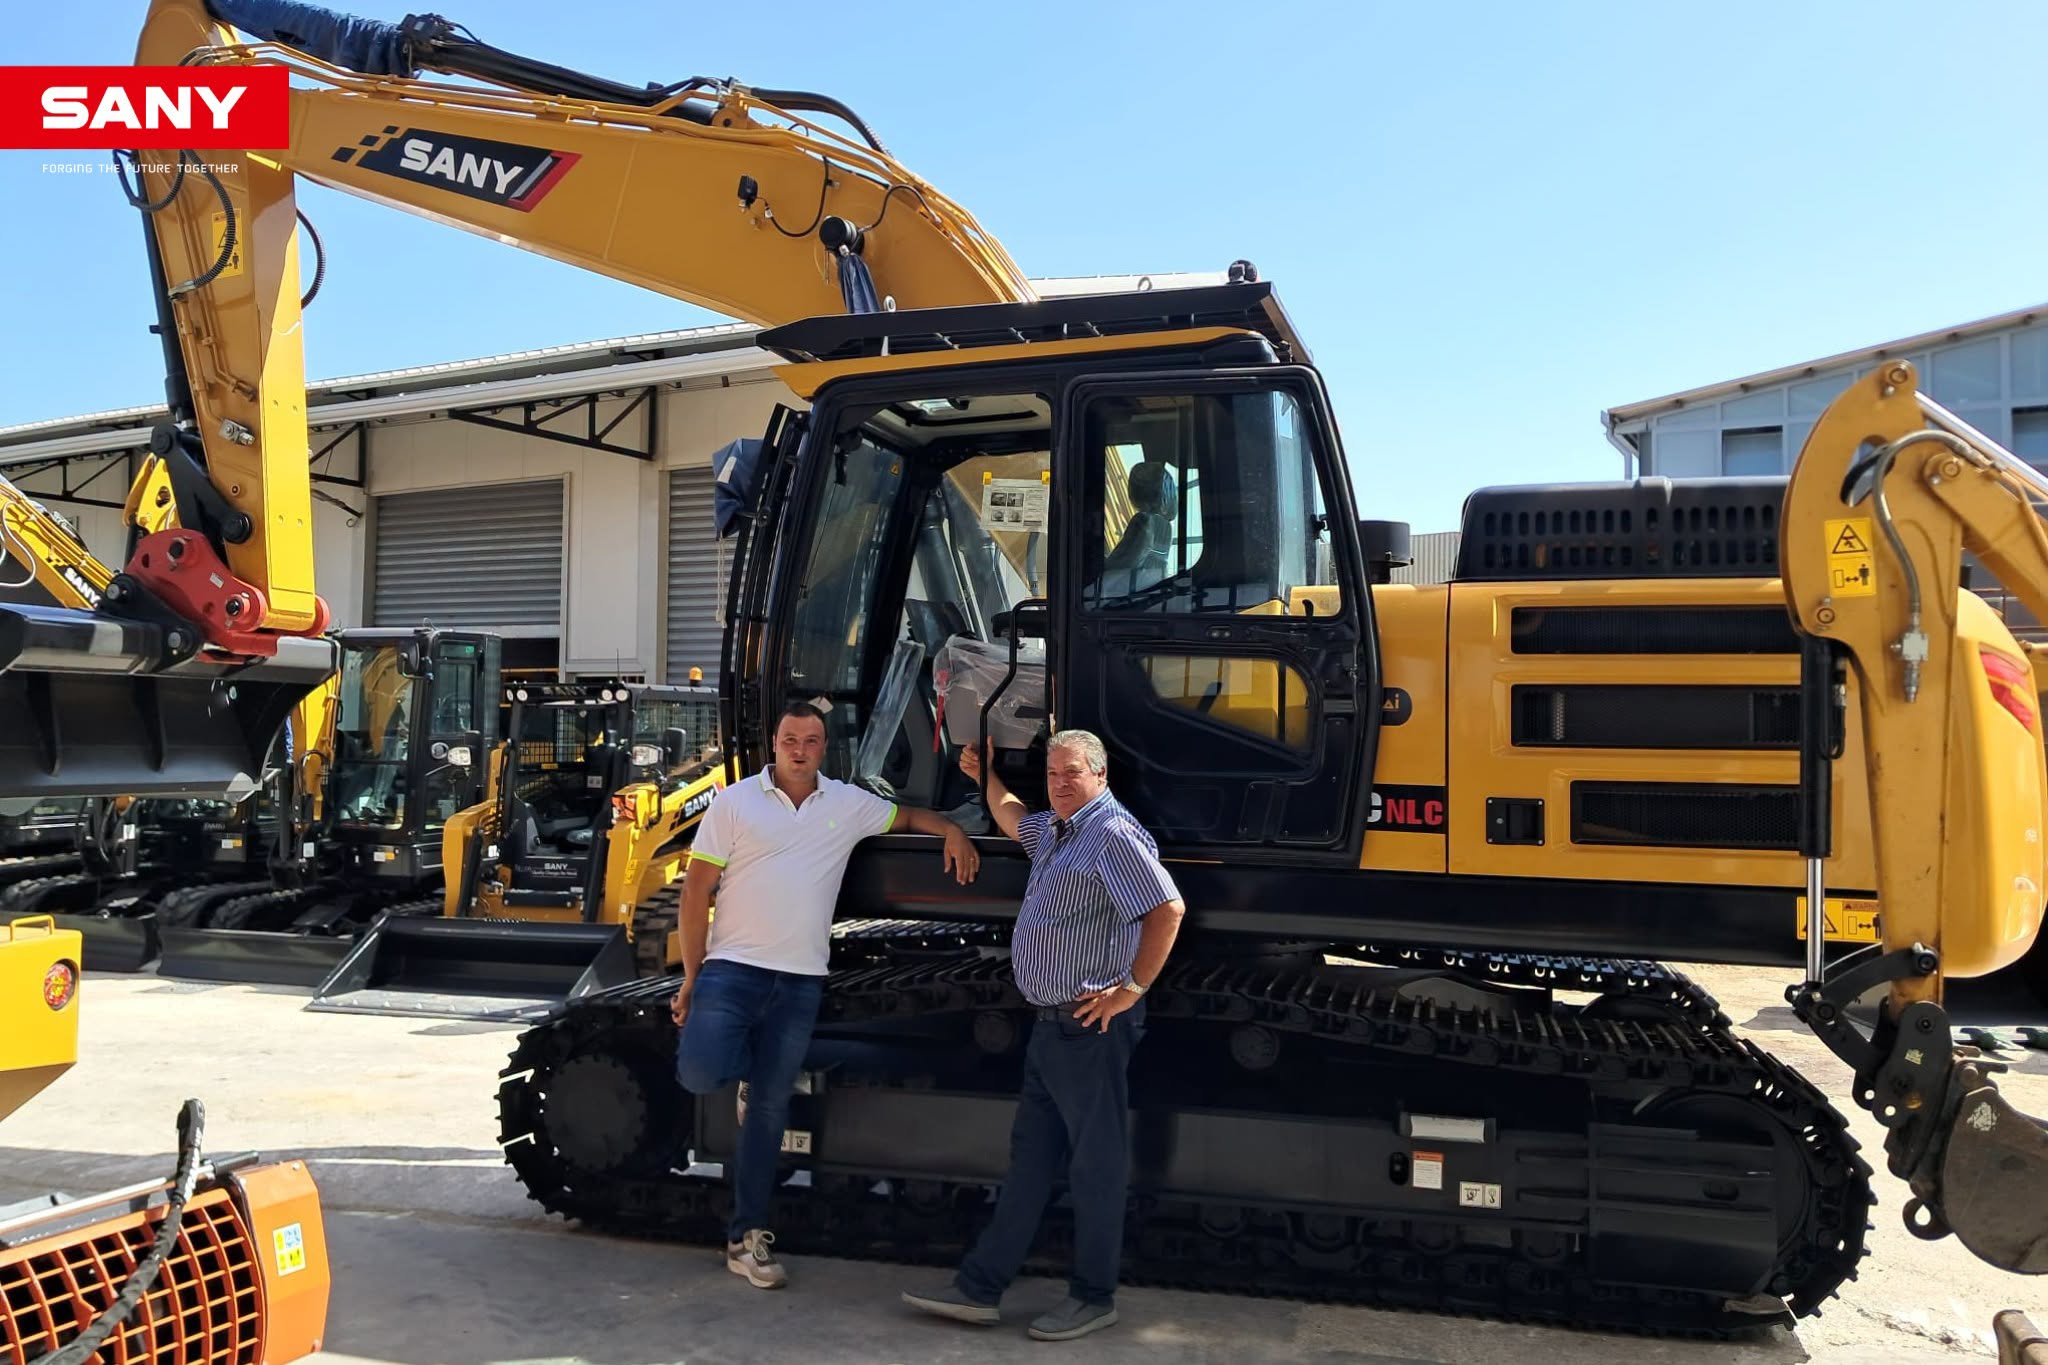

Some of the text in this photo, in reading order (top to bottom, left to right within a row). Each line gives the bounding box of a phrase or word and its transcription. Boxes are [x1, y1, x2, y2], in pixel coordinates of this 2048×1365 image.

[400, 138, 524, 194] SANY
[64, 567, 101, 603] SANY
[684, 788, 715, 817] SANY
